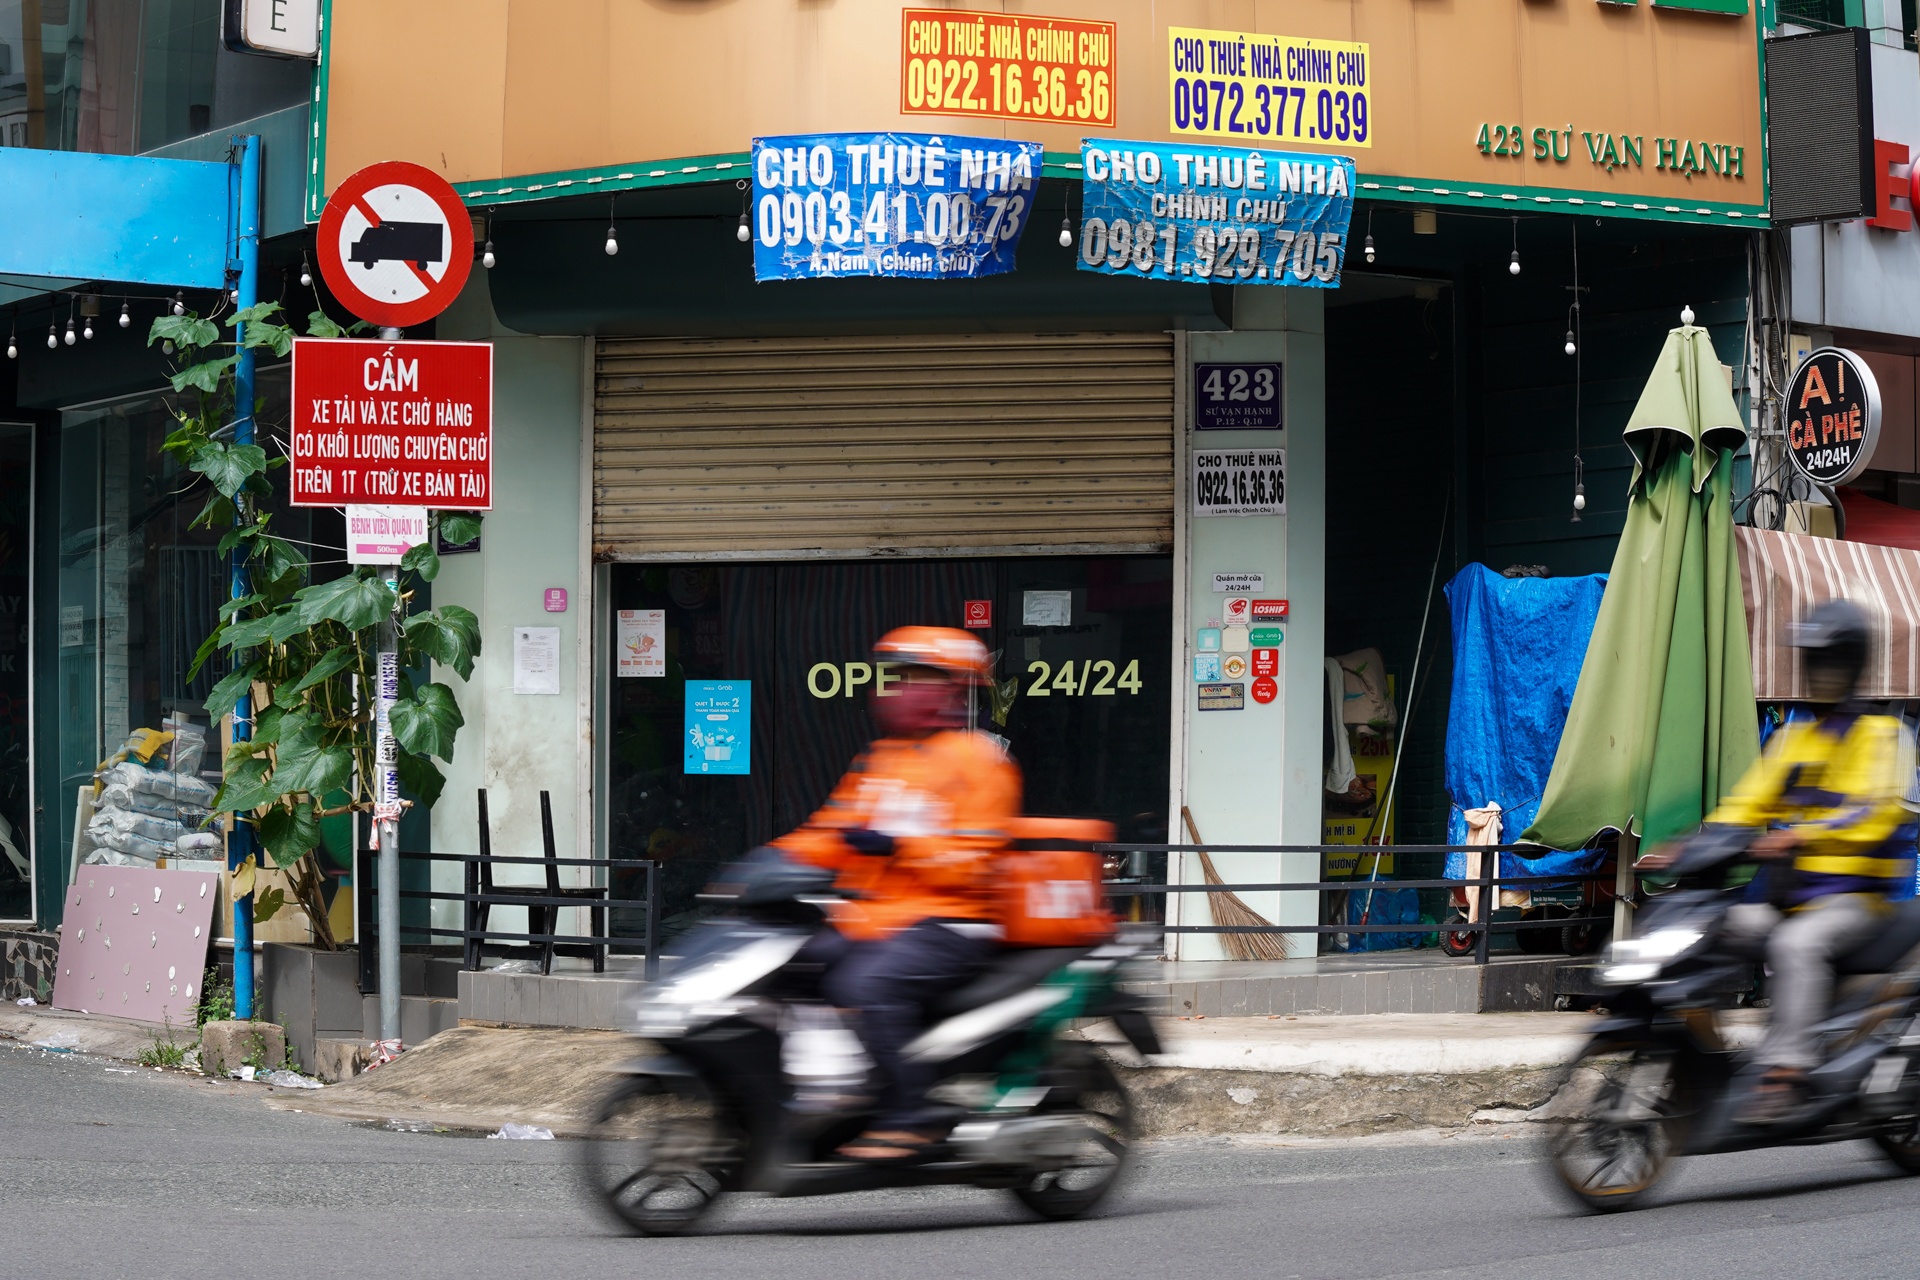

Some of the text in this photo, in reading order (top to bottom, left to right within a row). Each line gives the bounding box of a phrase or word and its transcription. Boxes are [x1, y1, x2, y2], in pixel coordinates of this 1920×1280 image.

[909, 17, 1109, 67] CHO THUÊ NHÀ CHÍNH CHỦ
[1174, 35, 1365, 87] CHO THUÊ NHÀ CHÍNH CHỦ
[908, 58, 1109, 120] 0922.16.36.36
[1174, 77, 1368, 143] 0972.377.039
[757, 136, 1033, 191] CHO THUÊ NHÀ
[1476, 123, 1744, 177] 423 SƯ VẠN HẠNH
[1085, 149, 1349, 198] CHO THUÊ NHÀ
[758, 190, 1025, 248] 0903.41.00.73
[1151, 188, 1286, 225] CHÍNH CHỦ
[809, 253, 869, 272] A.Nam
[876, 251, 932, 275] (chính
[1081, 217, 1342, 284] 0981.929.705
[363, 346, 419, 393] CẤM
[1203, 368, 1275, 402] 423
[312, 395, 473, 427] XE TẢI VÀ XE CHỞ HÀNG
[1205, 406, 1272, 417] SƯ VẠN HẠNH
[1216, 418, 1235, 426] P.12
[1243, 418, 1263, 426] Q.10
[1790, 402, 1862, 450] CÀ PHÊ
[296, 427, 488, 463] CÓ KHỐI LƯỢNG CHUYÊN CHỞ
[1197, 451, 1282, 467] CHO THUÊ NHÀ
[1806, 445, 1851, 471] 24/24H
[296, 466, 486, 499] TRÊN 1T (TRỪ XE BÁN TẢI)
[1197, 470, 1285, 506] 0922.16.36.36
[351, 514, 423, 538] BỆNH VIỆN QUẬN 10
[1216, 574, 1262, 582] Quán mở cửa
[1253, 605, 1285, 614] LOSHIP
[807, 659, 1143, 699] OPE 24/24
[709, 697, 714, 707] 1
